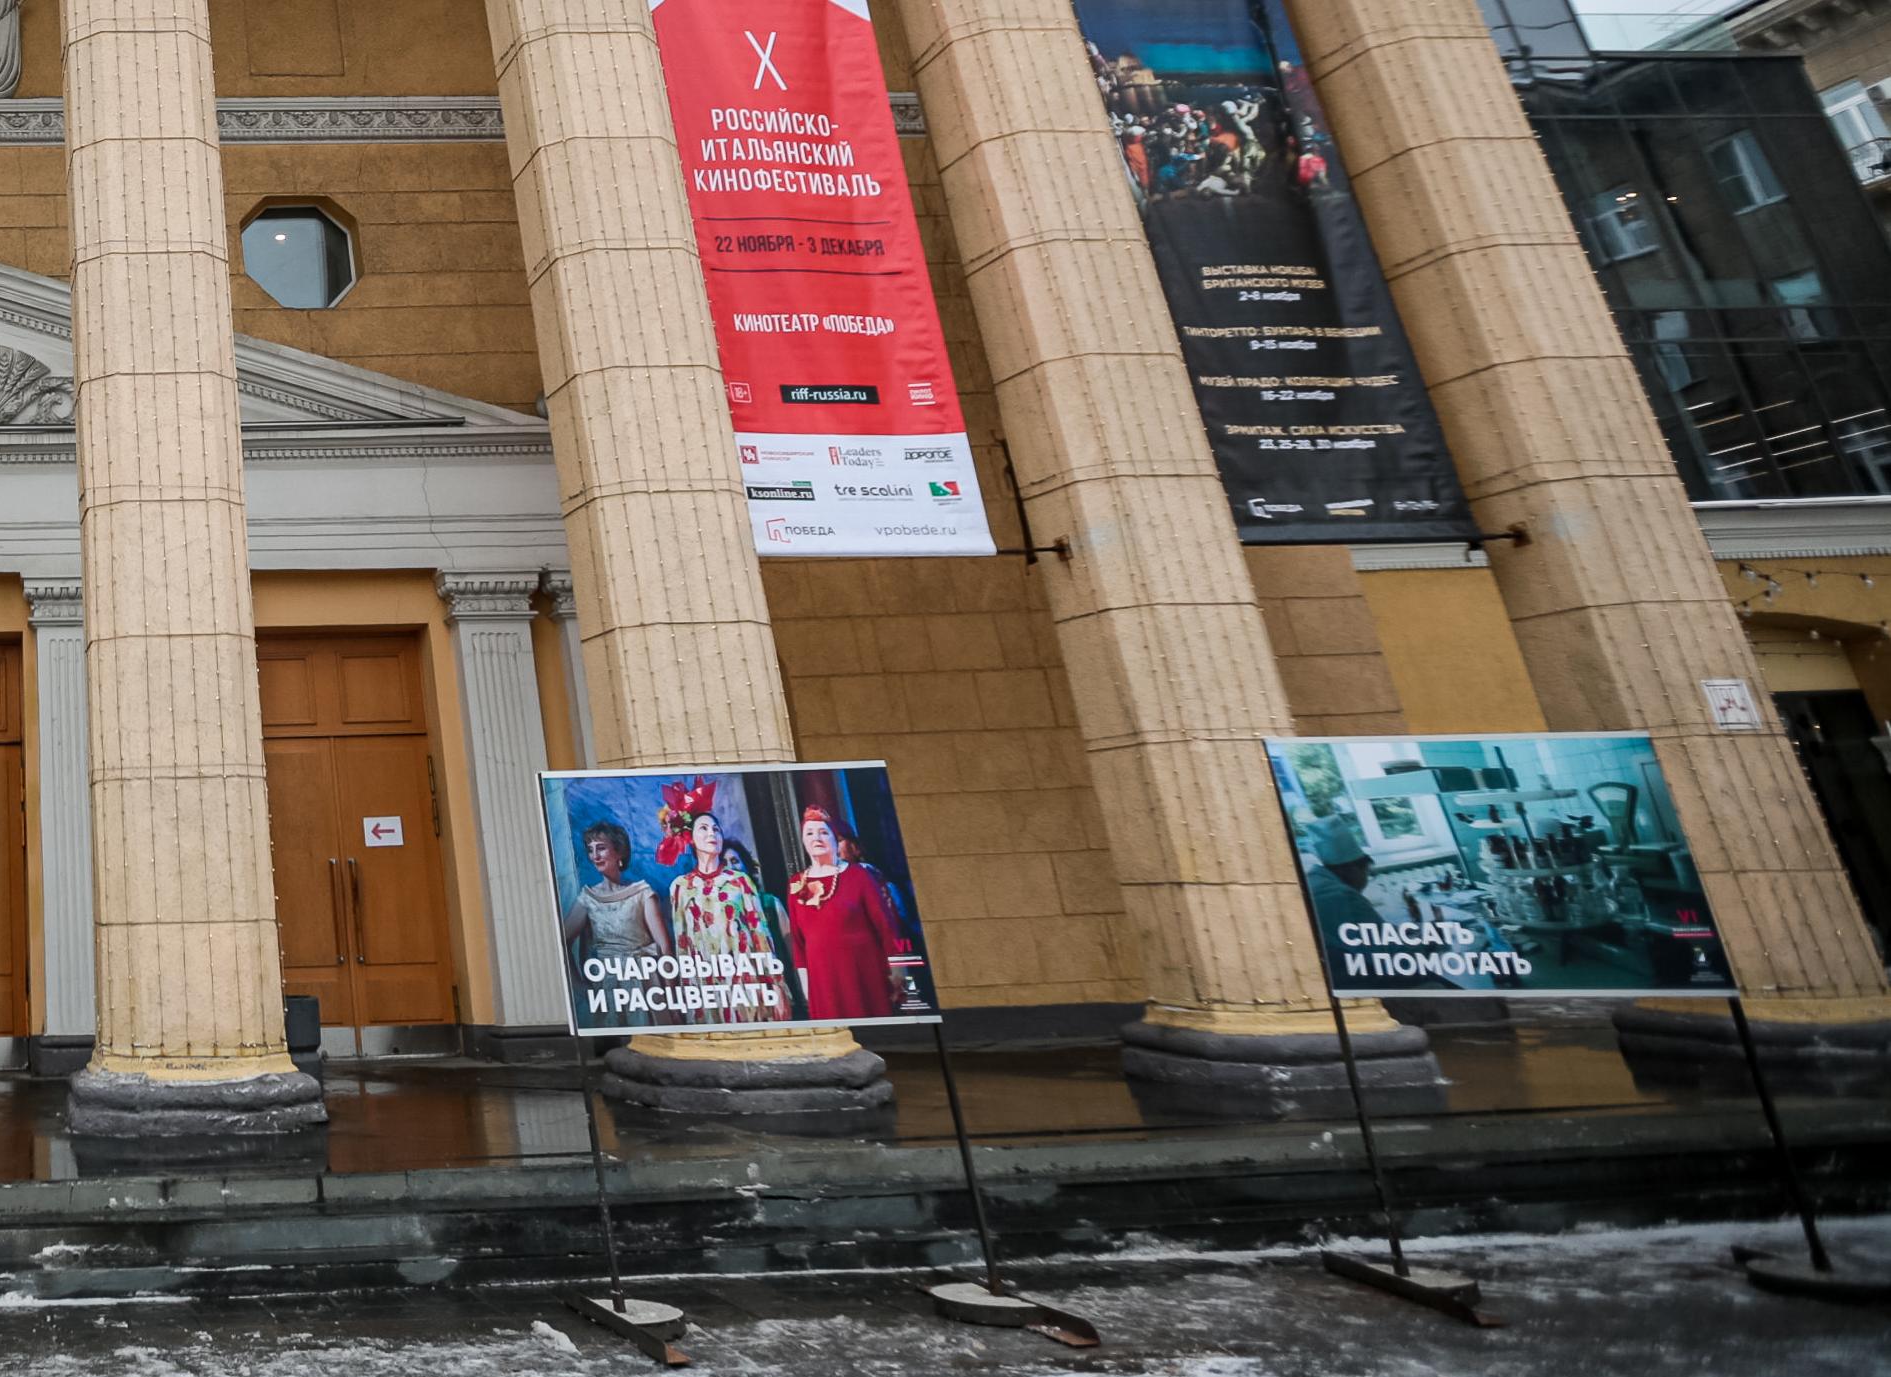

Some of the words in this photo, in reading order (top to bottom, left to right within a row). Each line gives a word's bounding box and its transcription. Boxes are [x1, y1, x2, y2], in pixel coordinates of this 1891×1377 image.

[710, 106, 839, 138] РОССИЙСКО-
[700, 138, 855, 168] ИТАЛЬЯНСКИЙ
[693, 168, 881, 198] КИНОФЕСТИВАЛЬ
[714, 236, 734, 253] 22
[736, 235, 795, 253] НОЯБРЯ
[807, 236, 818, 253] 3
[820, 237, 886, 256] ДЕКАБРЯ
[1202, 265, 1267, 277] ВЫСТАВКА
[1202, 278, 1290, 289] БРИТАНСКОГО
[1239, 291, 1261, 301] 2-8
[733, 314, 819, 333] КИНОТЕАТР
[822, 314, 895, 336] «ПОБЕДА»
[791, 387, 867, 401] riff-russia.ru
[838, 446, 882, 456] Leaders
[840, 457, 874, 469] Today
[751, 488, 813, 500] ksonline.ru
[834, 484, 857, 496] tre
[861, 484, 914, 497] scolini
[784, 526, 836, 536] ПОБЕДА
[876, 524, 957, 536] vpobede.ru
[1338, 922, 1474, 946] СПАСАТЬ
[583, 951, 784, 982] ОЧАРОВЫВАТЬ
[1345, 953, 1367, 976] И
[1374, 951, 1532, 977] ПОМОГАТЬ
[587, 989, 608, 1014] И
[614, 983, 779, 1014] РАСЦВЕТАТЬ
